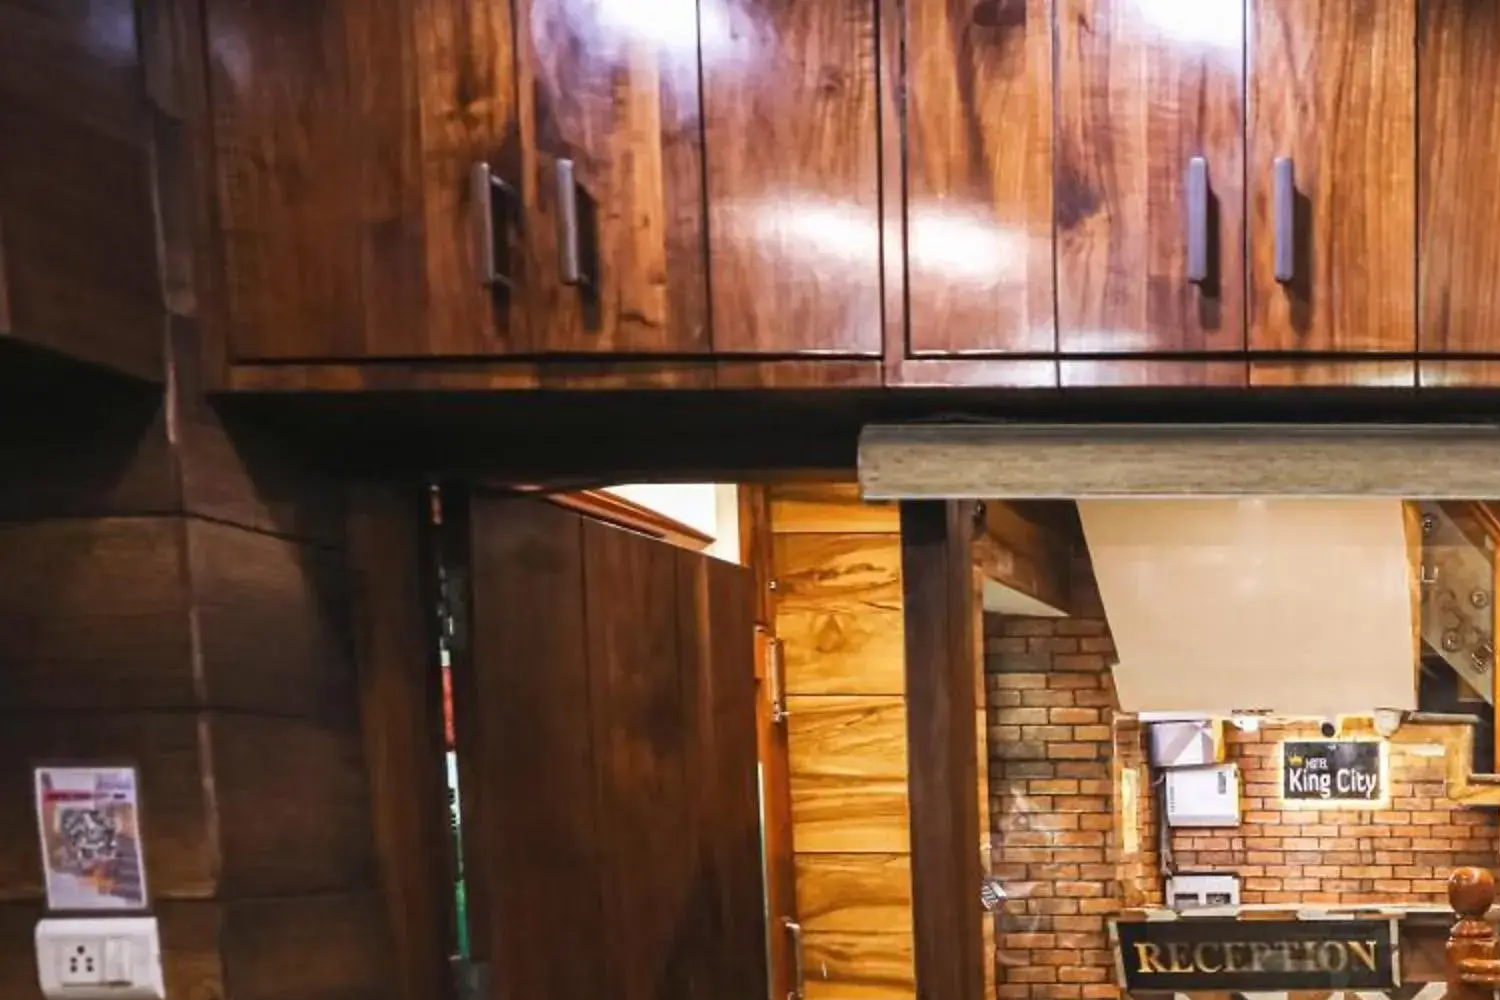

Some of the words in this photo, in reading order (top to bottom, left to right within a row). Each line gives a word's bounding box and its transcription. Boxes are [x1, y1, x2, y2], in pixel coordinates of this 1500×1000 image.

[1289, 767, 1332, 799] King
[1336, 767, 1377, 799] City
[1132, 939, 1378, 974] RECEPTION
